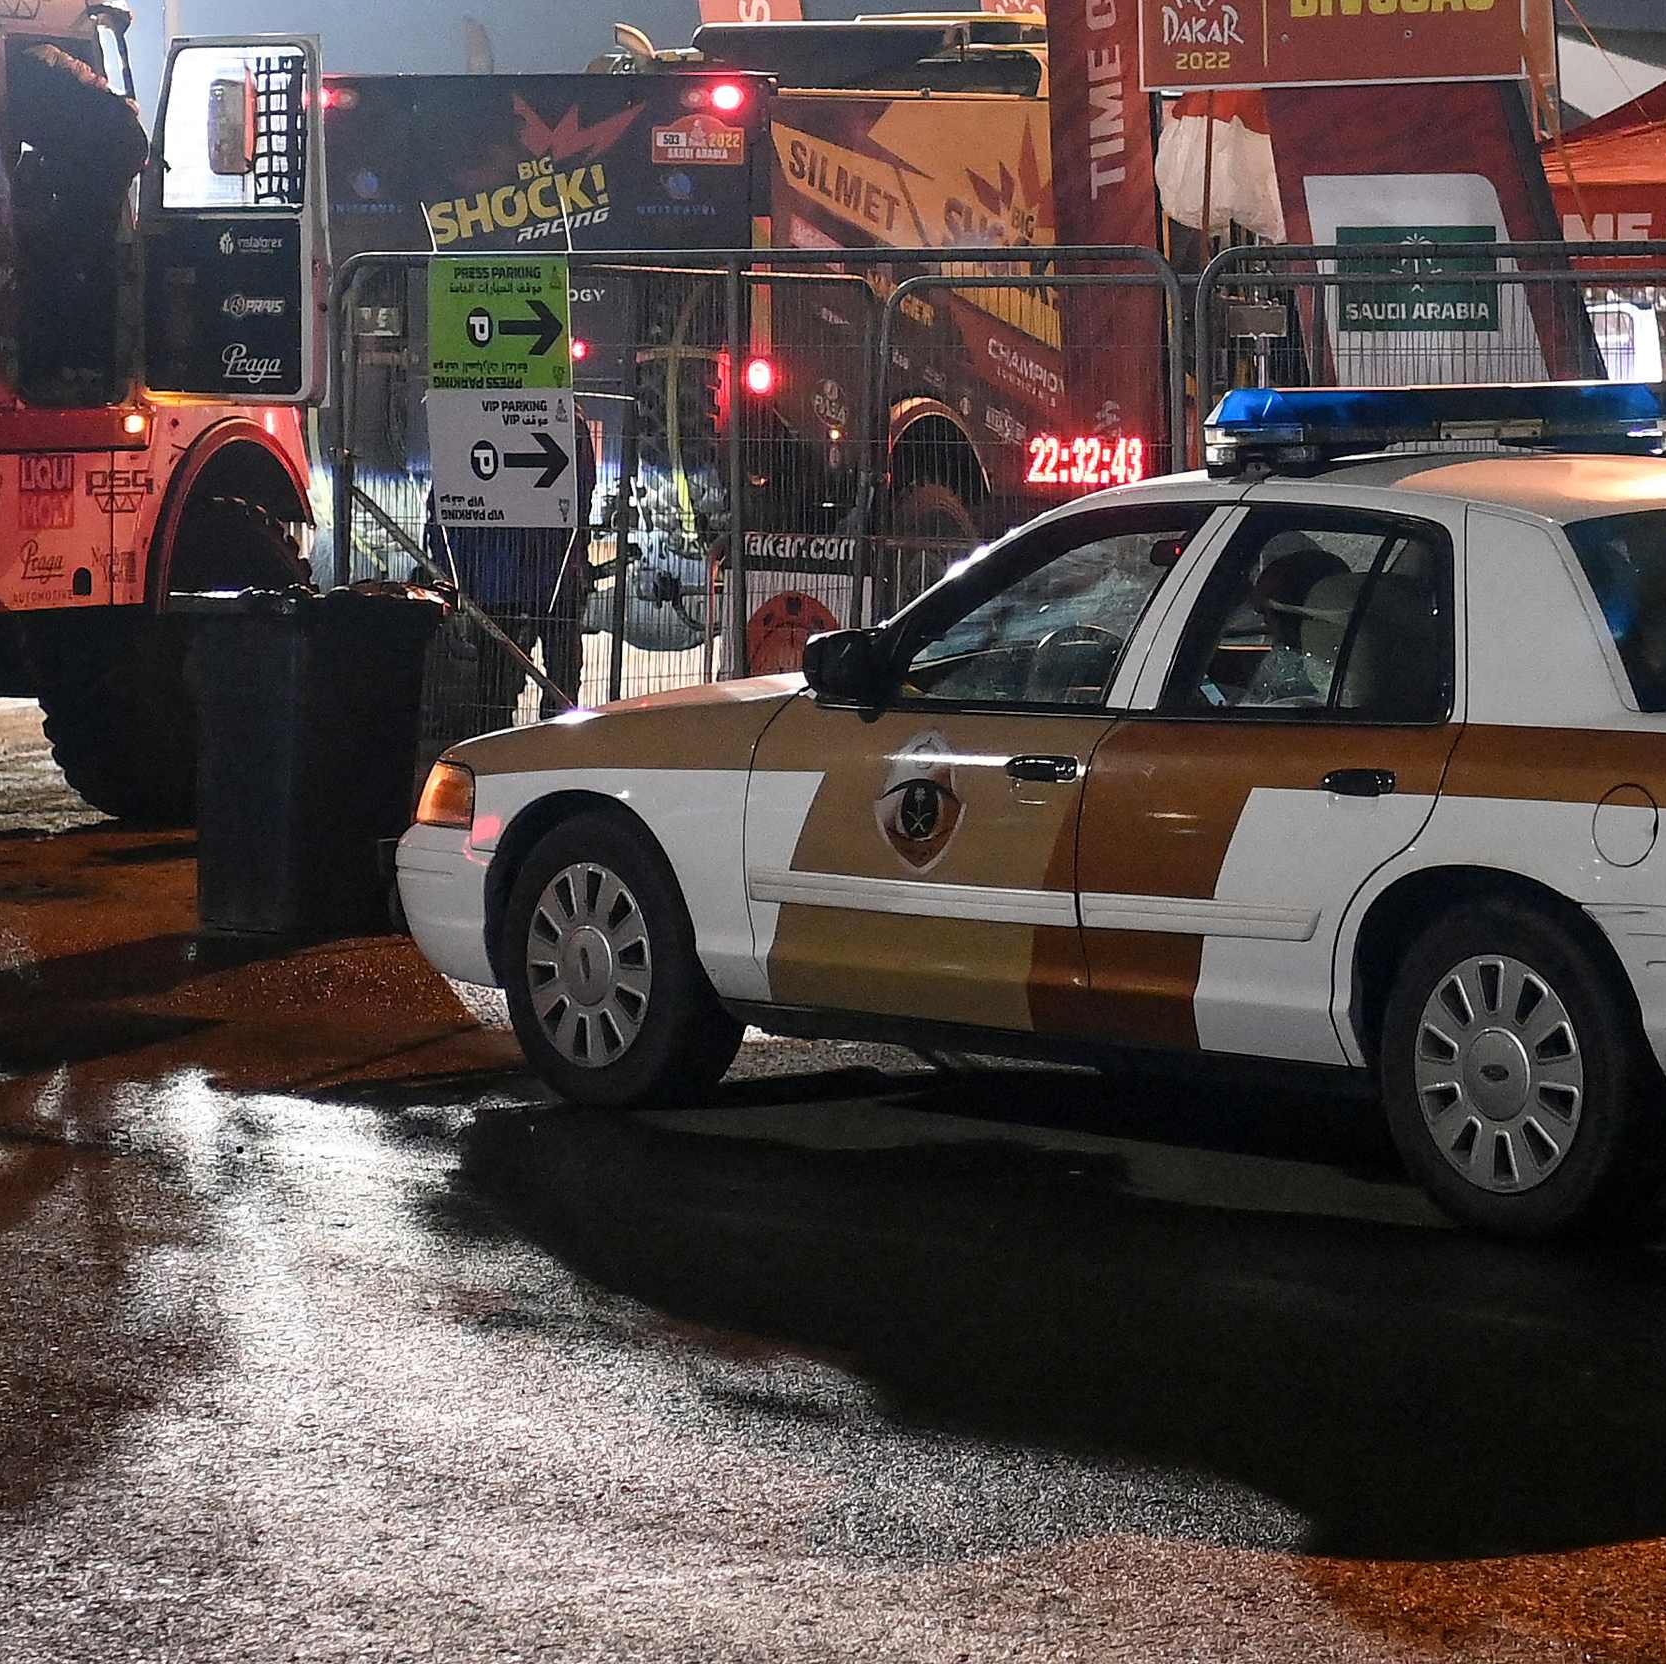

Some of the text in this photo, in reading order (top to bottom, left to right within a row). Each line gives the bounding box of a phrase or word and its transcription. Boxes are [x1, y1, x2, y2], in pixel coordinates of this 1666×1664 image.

[1162, 4, 1245, 45] DAKAR
[1175, 51, 1231, 70] 2022
[1087, 42, 1128, 200] TIME
[708, 132, 741, 148] 2022
[517, 157, 553, 181] BIG
[788, 139, 900, 231] SILMET
[427, 163, 611, 245] SHOCK!
[453, 266, 542, 280] PRESS PARKING
[1345, 302, 1490, 322] SAUDI ARABIA
[221, 342, 283, 384] Praga
[482, 400, 548, 412] VIP PARKING
[502, 414, 520, 426] VIP
[1027, 436, 1143, 484] 22:32:43
[20, 539, 66, 585] Praga
